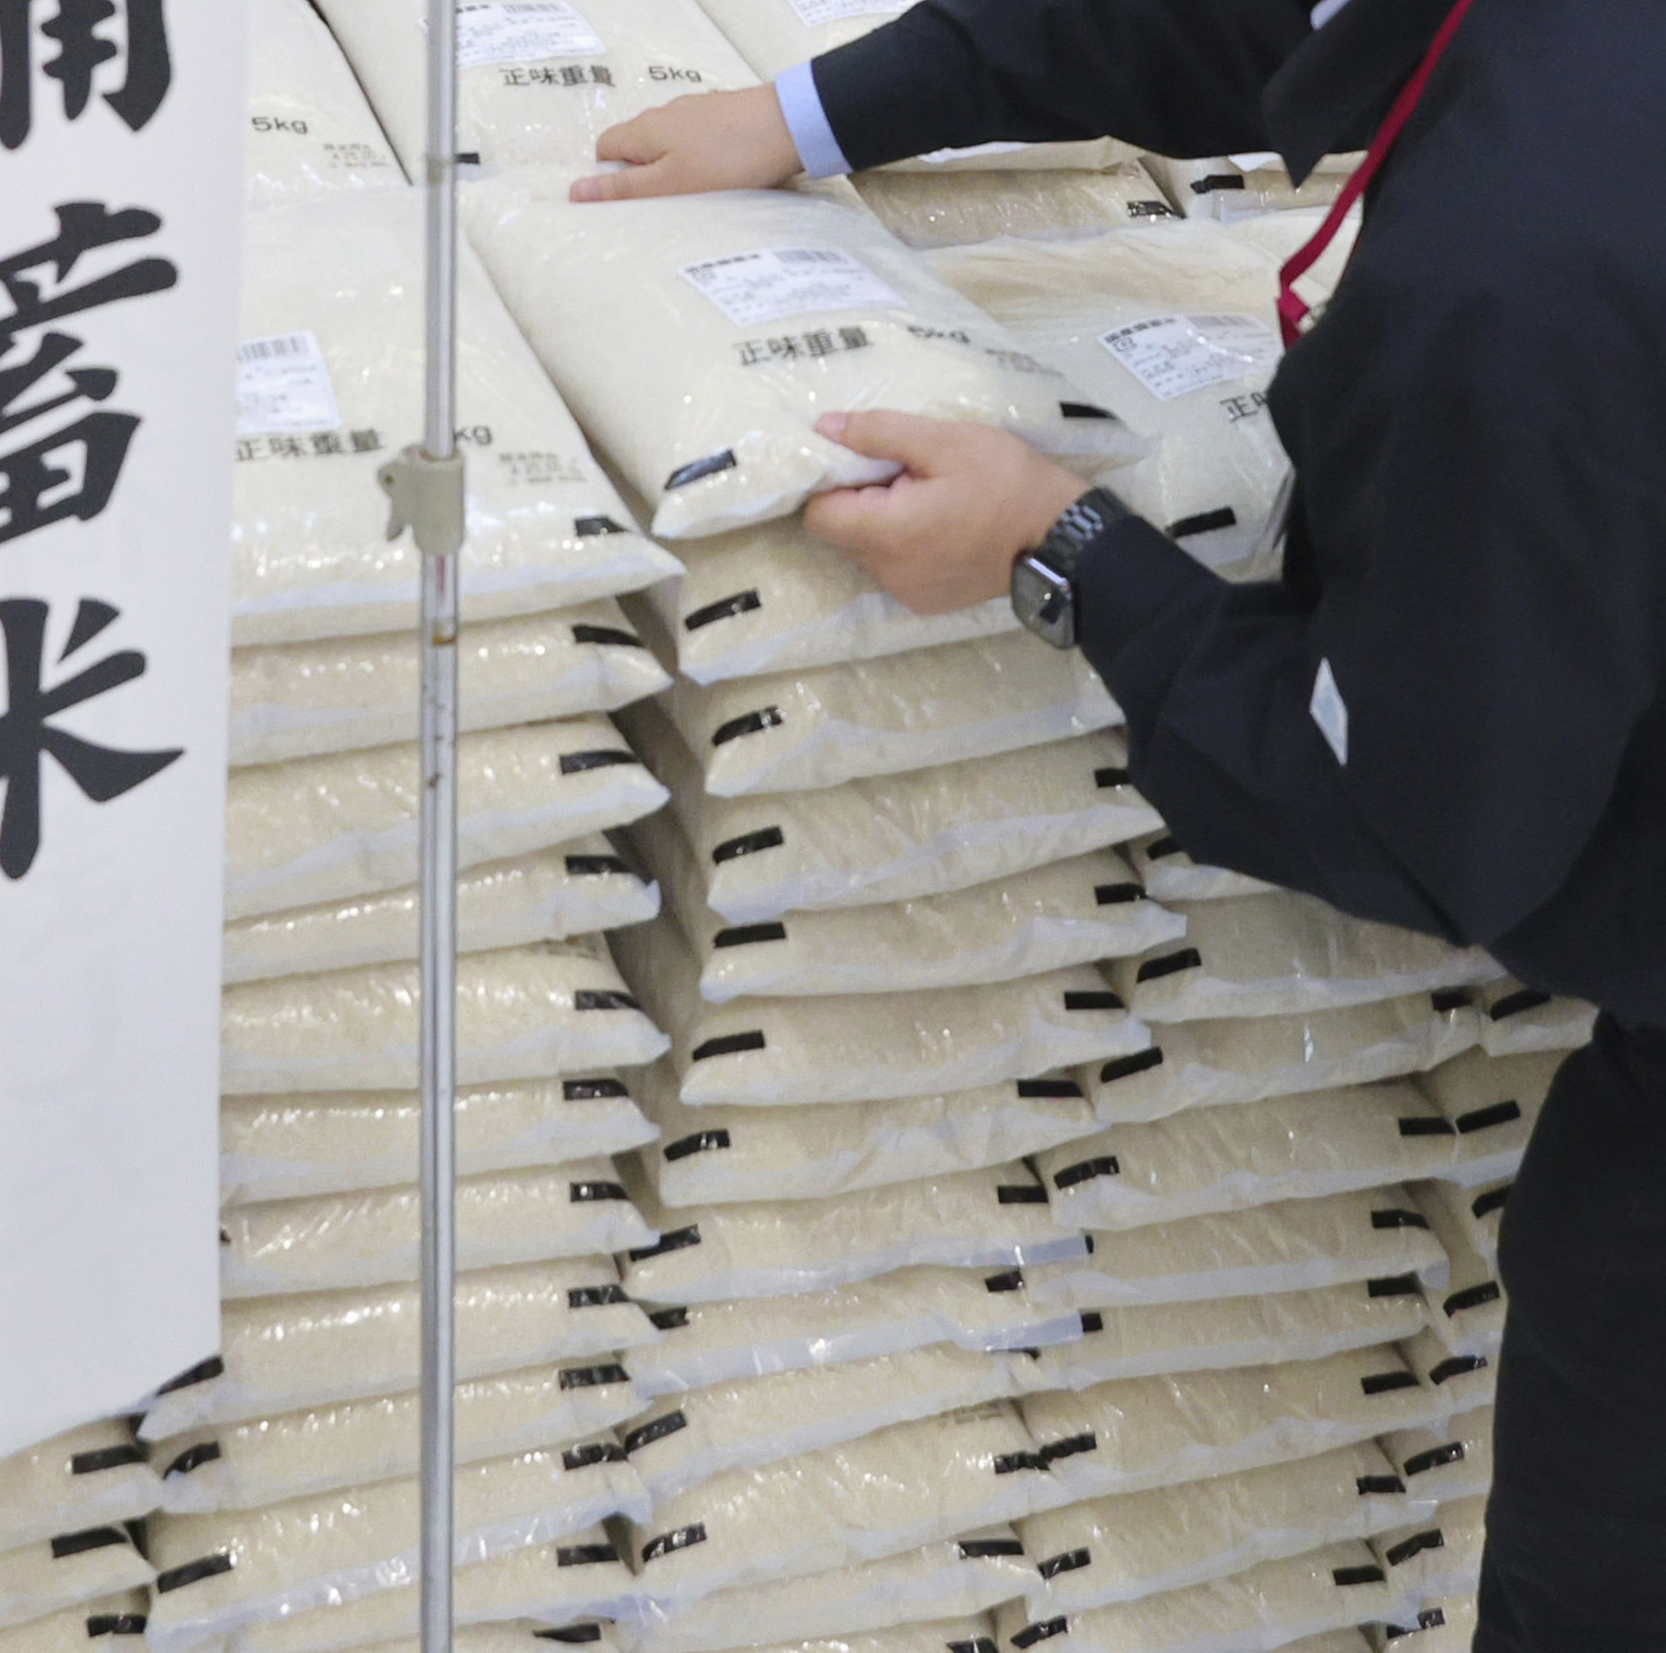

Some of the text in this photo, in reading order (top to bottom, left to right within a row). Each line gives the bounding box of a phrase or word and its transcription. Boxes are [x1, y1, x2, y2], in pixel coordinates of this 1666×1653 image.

[648, 65, 703, 83] 5kg
[251, 115, 309, 134] 5kg
[733, 325, 876, 368] 正味重量
